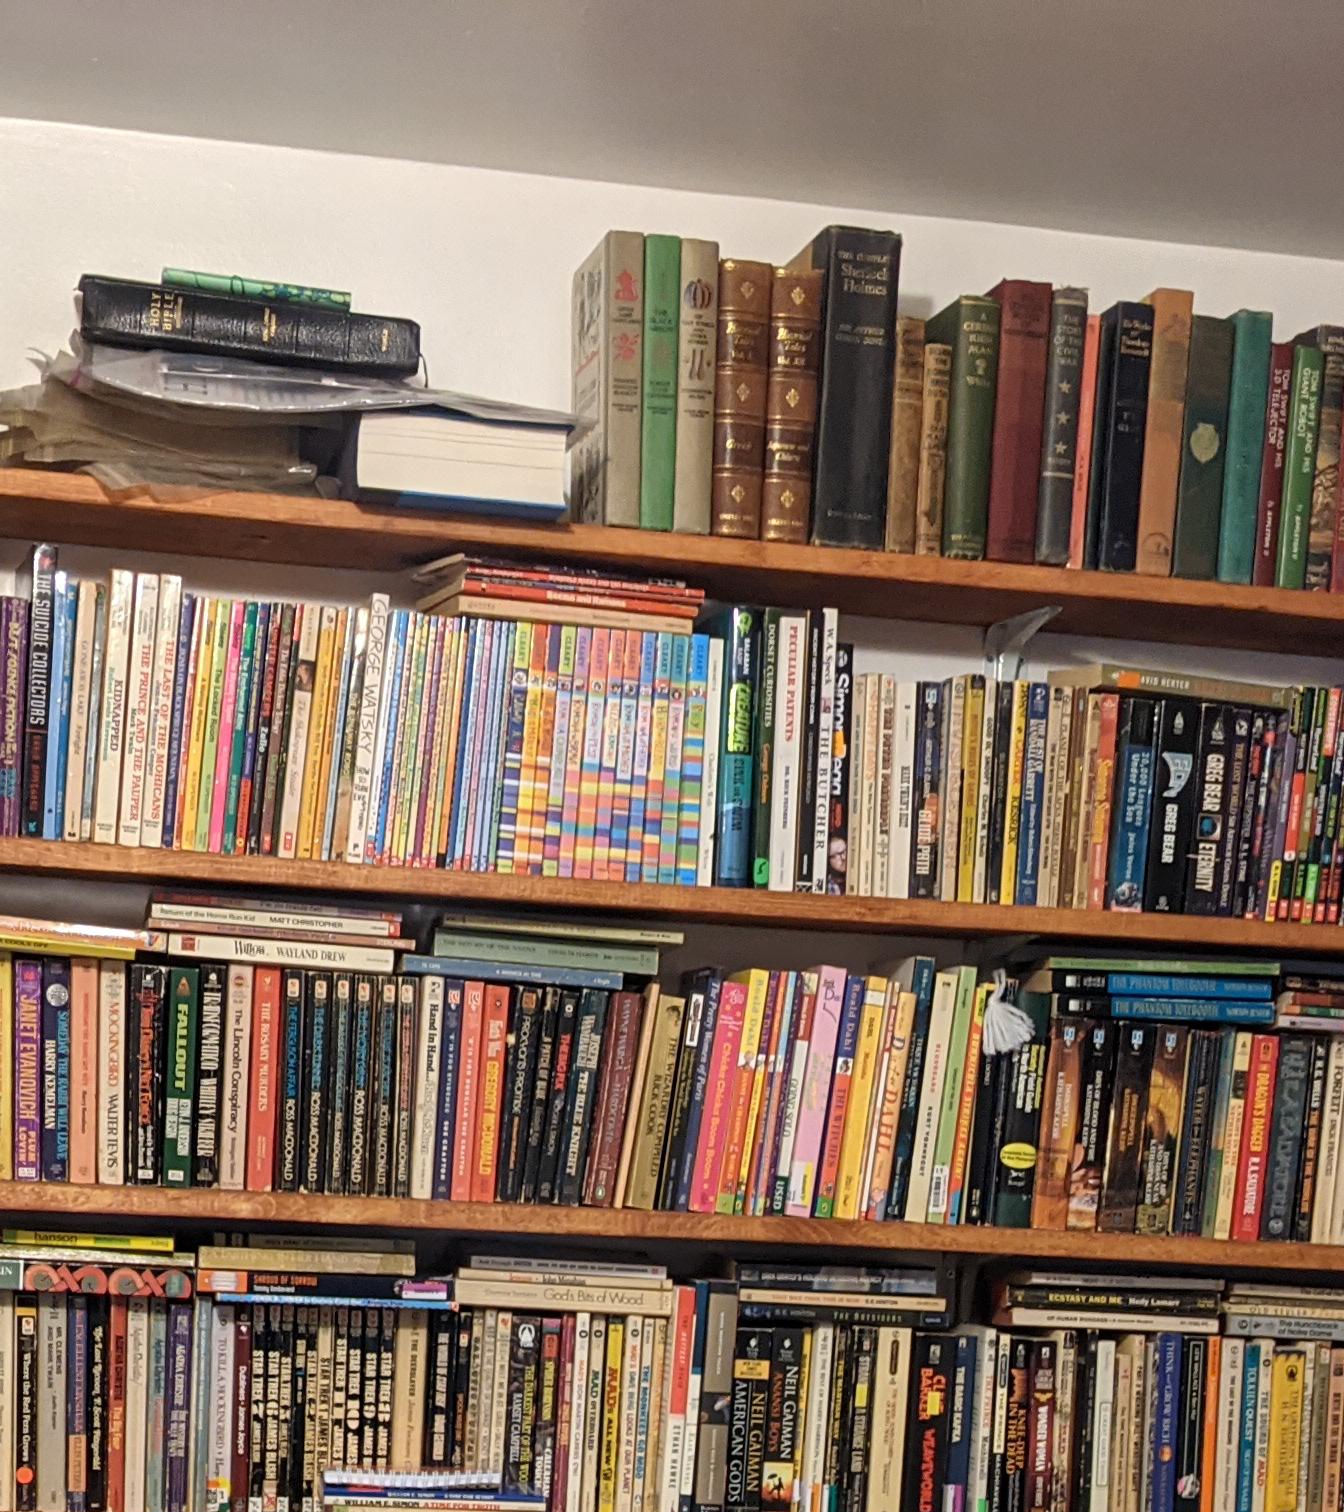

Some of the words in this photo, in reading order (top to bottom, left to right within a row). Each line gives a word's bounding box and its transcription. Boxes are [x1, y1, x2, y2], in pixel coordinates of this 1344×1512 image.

[368, 597, 387, 675] GEORGE
[110, 679, 123, 752] KIDNAPPED
[816, 766, 828, 850] BUTCHER
[19, 1042, 37, 1120] EVANOVICH
[175, 1003, 189, 1091] FALLOUT
[731, 1381, 747, 1456] AMERICAN
[784, 1365, 799, 1398] NEIL
[746, 1427, 762, 1492] GAIMAN
[780, 1400, 796, 1459] GAIMAN
[728, 1459, 743, 1502] GODS
